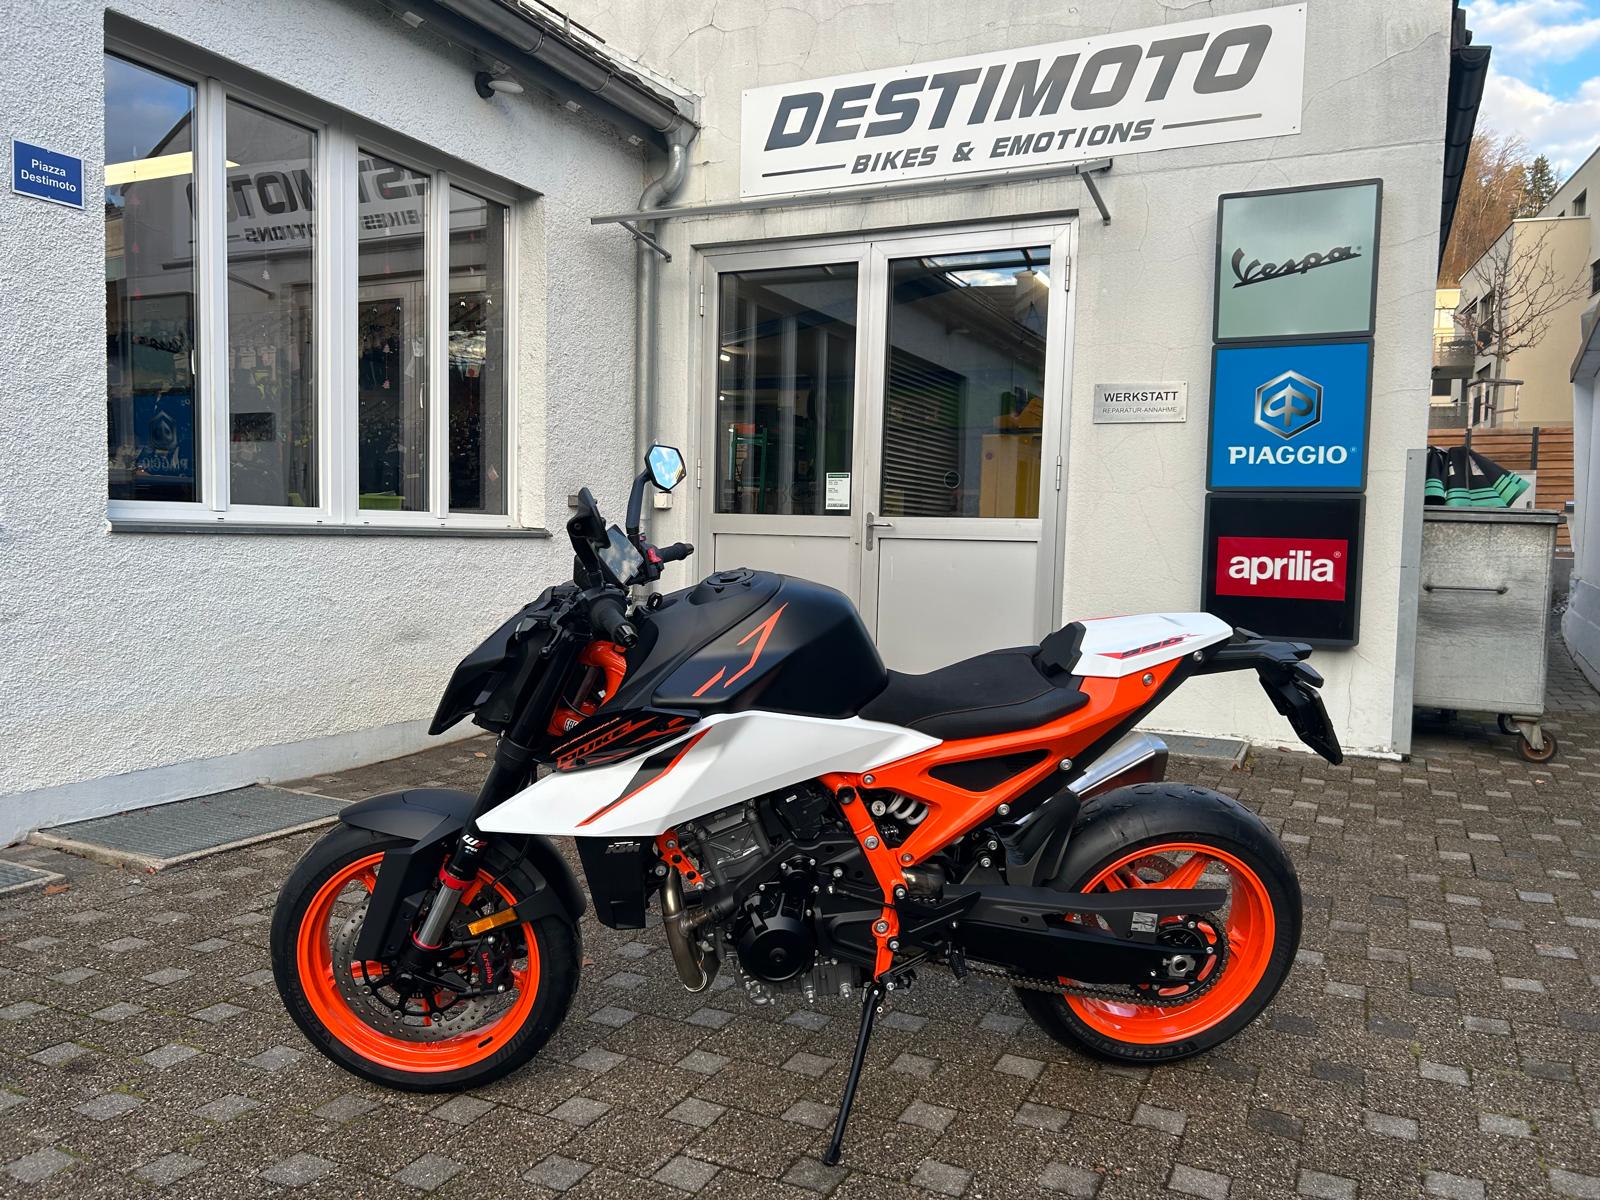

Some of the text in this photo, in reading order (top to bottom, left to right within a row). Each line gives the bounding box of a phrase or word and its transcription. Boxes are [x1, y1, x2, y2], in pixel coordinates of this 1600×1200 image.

[763, 24, 1273, 152] DESTIMOTO
[850, 118, 1156, 174] BIKES & EMOTIONS
[31, 158, 66, 177] Piazza
[21, 169, 77, 192] Destimoto
[1231, 246, 1363, 289] Vespa
[1103, 391, 1179, 402] WERKSTATT
[1102, 406, 1177, 414] REPARATUR-ANNAHME
[1228, 444, 1348, 465] PIAGGIO
[1228, 549, 1335, 585] aprilia
